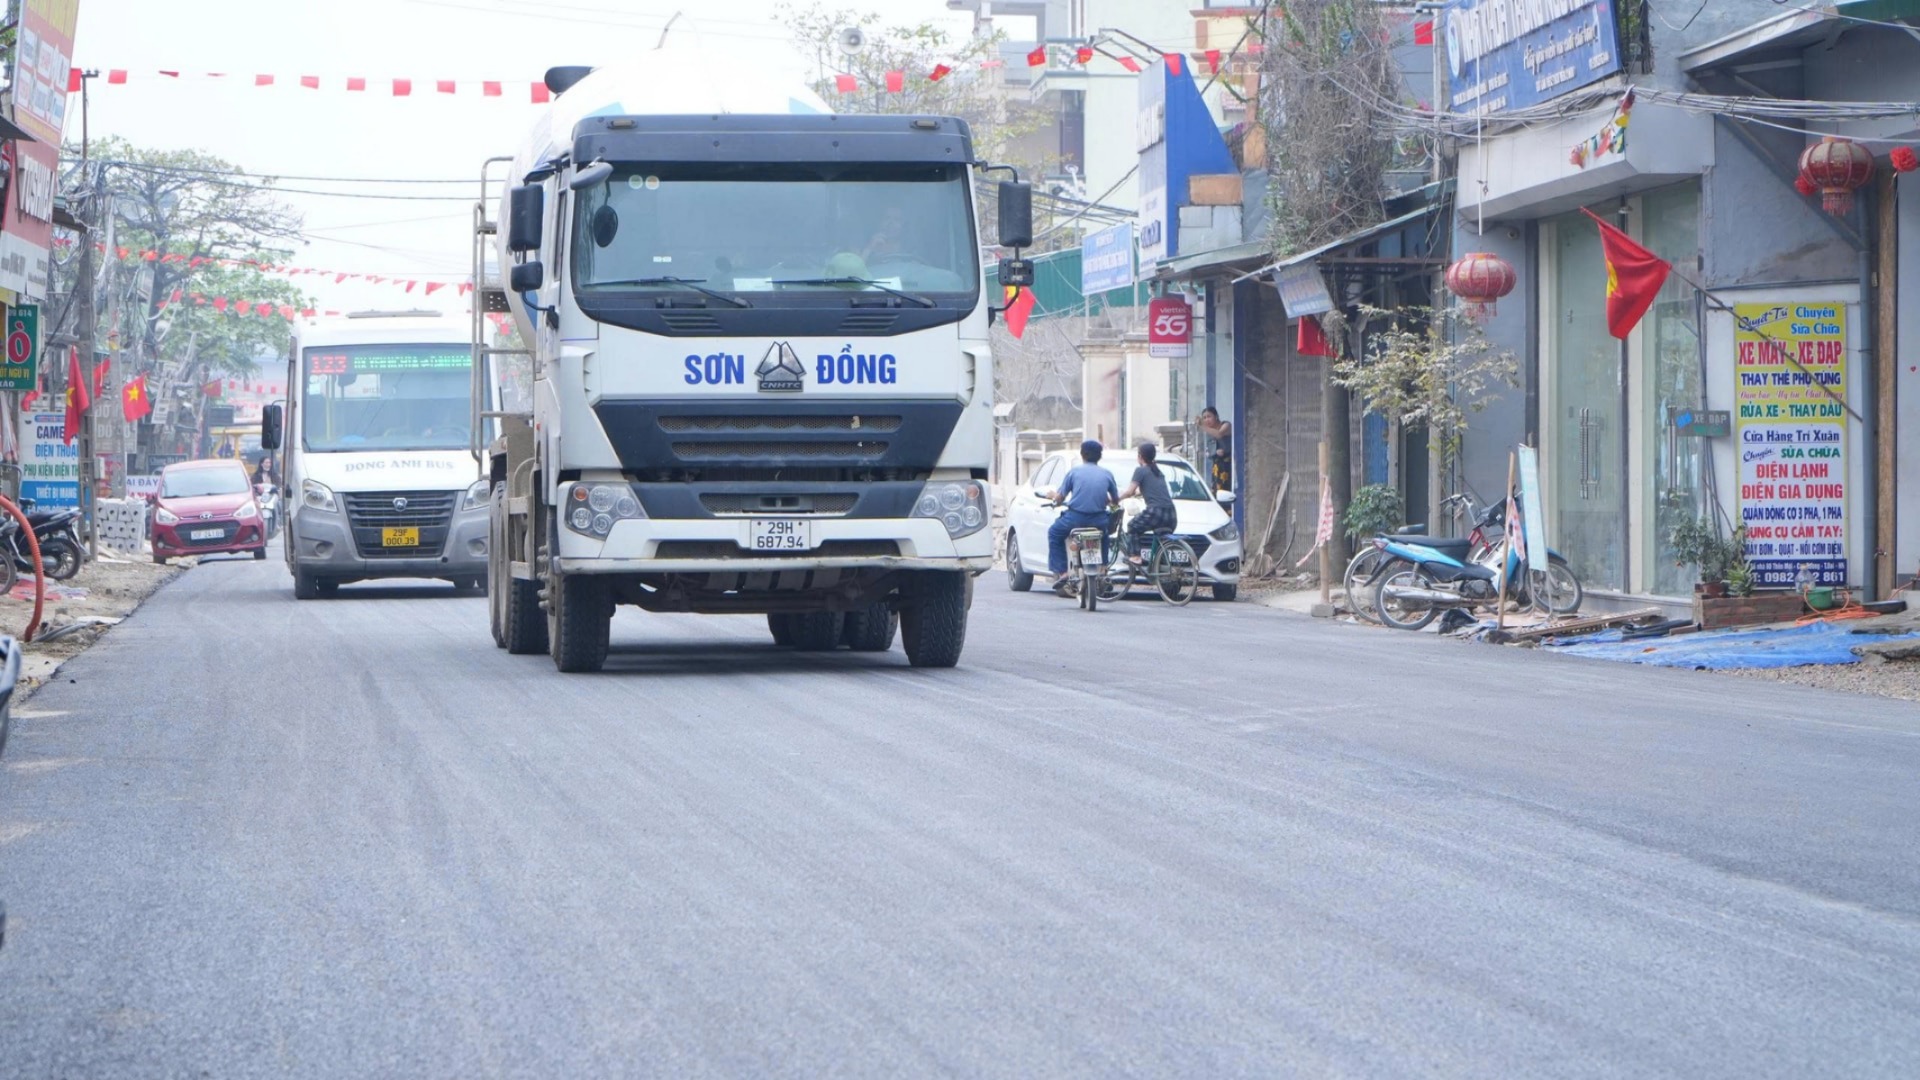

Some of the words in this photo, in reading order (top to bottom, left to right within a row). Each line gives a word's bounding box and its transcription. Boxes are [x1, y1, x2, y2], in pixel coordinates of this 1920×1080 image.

[1796, 307, 1835, 319] Chuyên
[1154, 314, 1187, 336] 5G
[1738, 341, 1754, 365] XE
[1758, 337, 1787, 365] MÁY
[1798, 341, 1814, 365] XE
[1817, 341, 1842, 368] ĐẠP
[311, 355, 347, 374] 123
[684, 352, 745, 385] SƠN
[815, 343, 897, 384] ĐỒNG
[760, 381, 801, 391] CNHTC
[1741, 373, 1769, 386] THAY
[1740, 400, 1763, 418] RỬA
[1766, 404, 1779, 417] XE
[1788, 404, 1817, 418] THAY
[1766, 430, 1793, 442] Hàng
[1813, 429, 1840, 441] Xuân
[1781, 445, 1805, 458] SỬA
[1808, 446, 1840, 458] CHỮA
[390, 459, 421, 469] ANH
[426, 460, 454, 470] BUS
[1756, 461, 1788, 481] ĐIỆN
[1792, 463, 1829, 481] LẠNH
[1741, 481, 1774, 502] ĐIỆN
[1778, 484, 1802, 499] GIA
[1805, 484, 1843, 502] DỤNG
[1798, 507, 1803, 519] 3
[1827, 506, 1842, 519] PHA
[767, 521, 794, 535] 29H
[1775, 526, 1788, 540] CỤ
[1817, 525, 1843, 538] TAY:
[756, 535, 804, 549] 687.94
[1764, 570, 1795, 583] 0982
